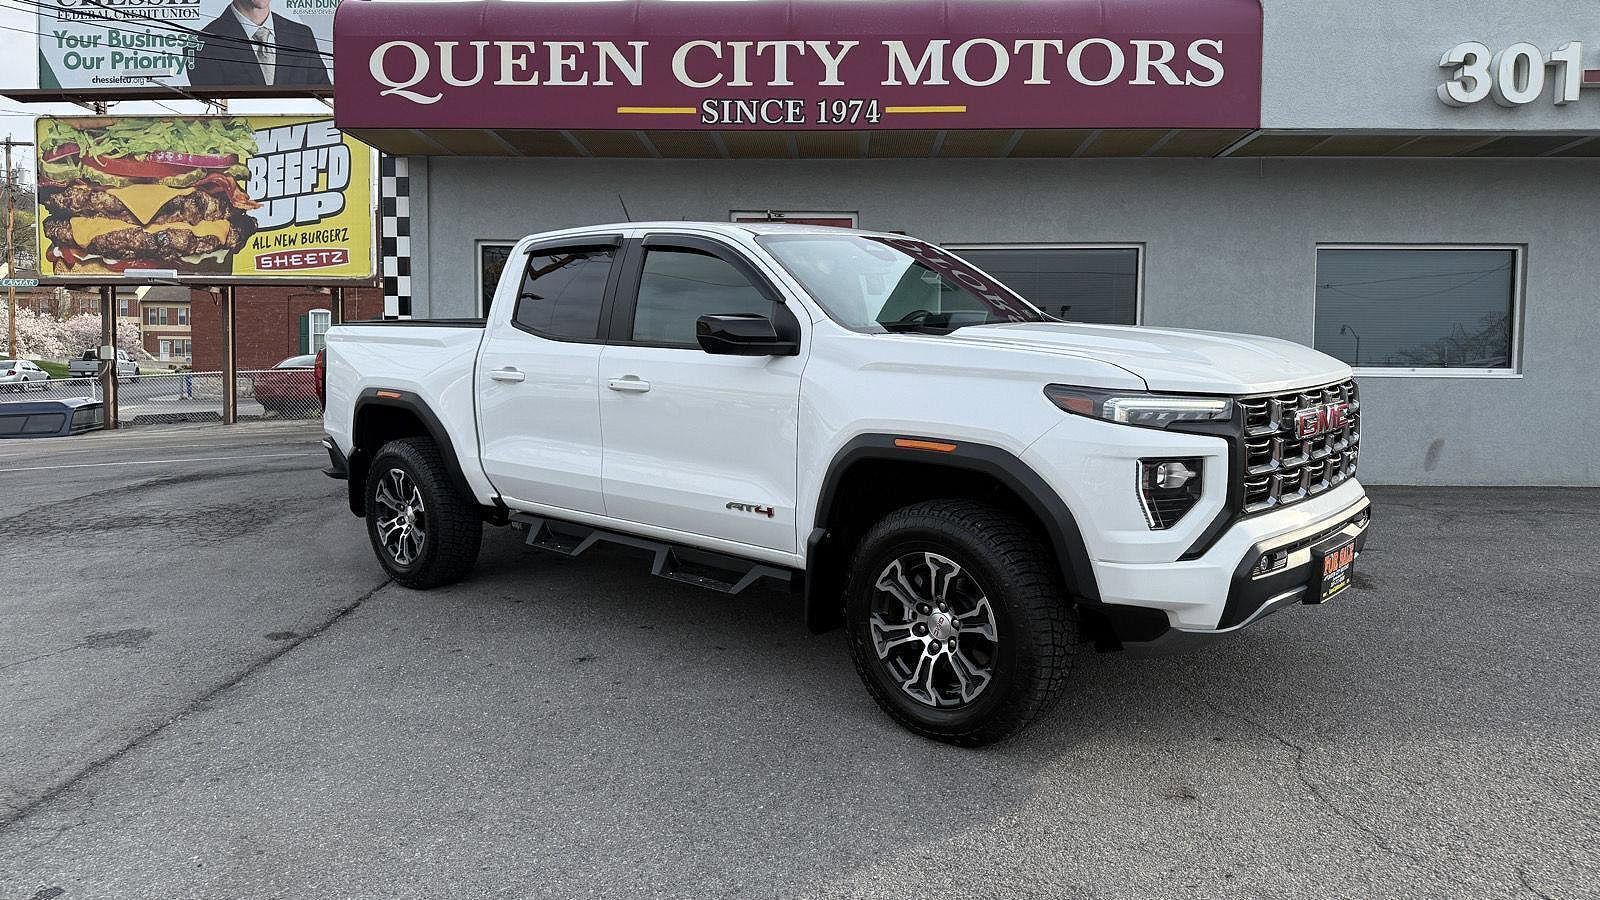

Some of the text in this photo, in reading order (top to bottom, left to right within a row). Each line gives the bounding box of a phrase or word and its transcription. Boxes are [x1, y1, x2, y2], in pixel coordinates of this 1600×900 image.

[57, 8, 200, 21] FEDERAL CREDIT UNION
[53, 30, 101, 49] Your
[63, 49, 195, 75] Our Priority!
[369, 38, 1225, 105] QUEEN CITY MOTORS
[1437, 40, 1583, 108] 301
[701, 99, 881, 124] SINCE 1974
[254, 120, 343, 155] WE
[246, 145, 350, 201] BEEF'D
[247, 191, 345, 229] UP
[253, 228, 349, 250] ALL NEW BURGERZ
[261, 251, 344, 269] SHEETZ
[1295, 401, 1350, 440] GMC
[726, 502, 775, 518] AT4
